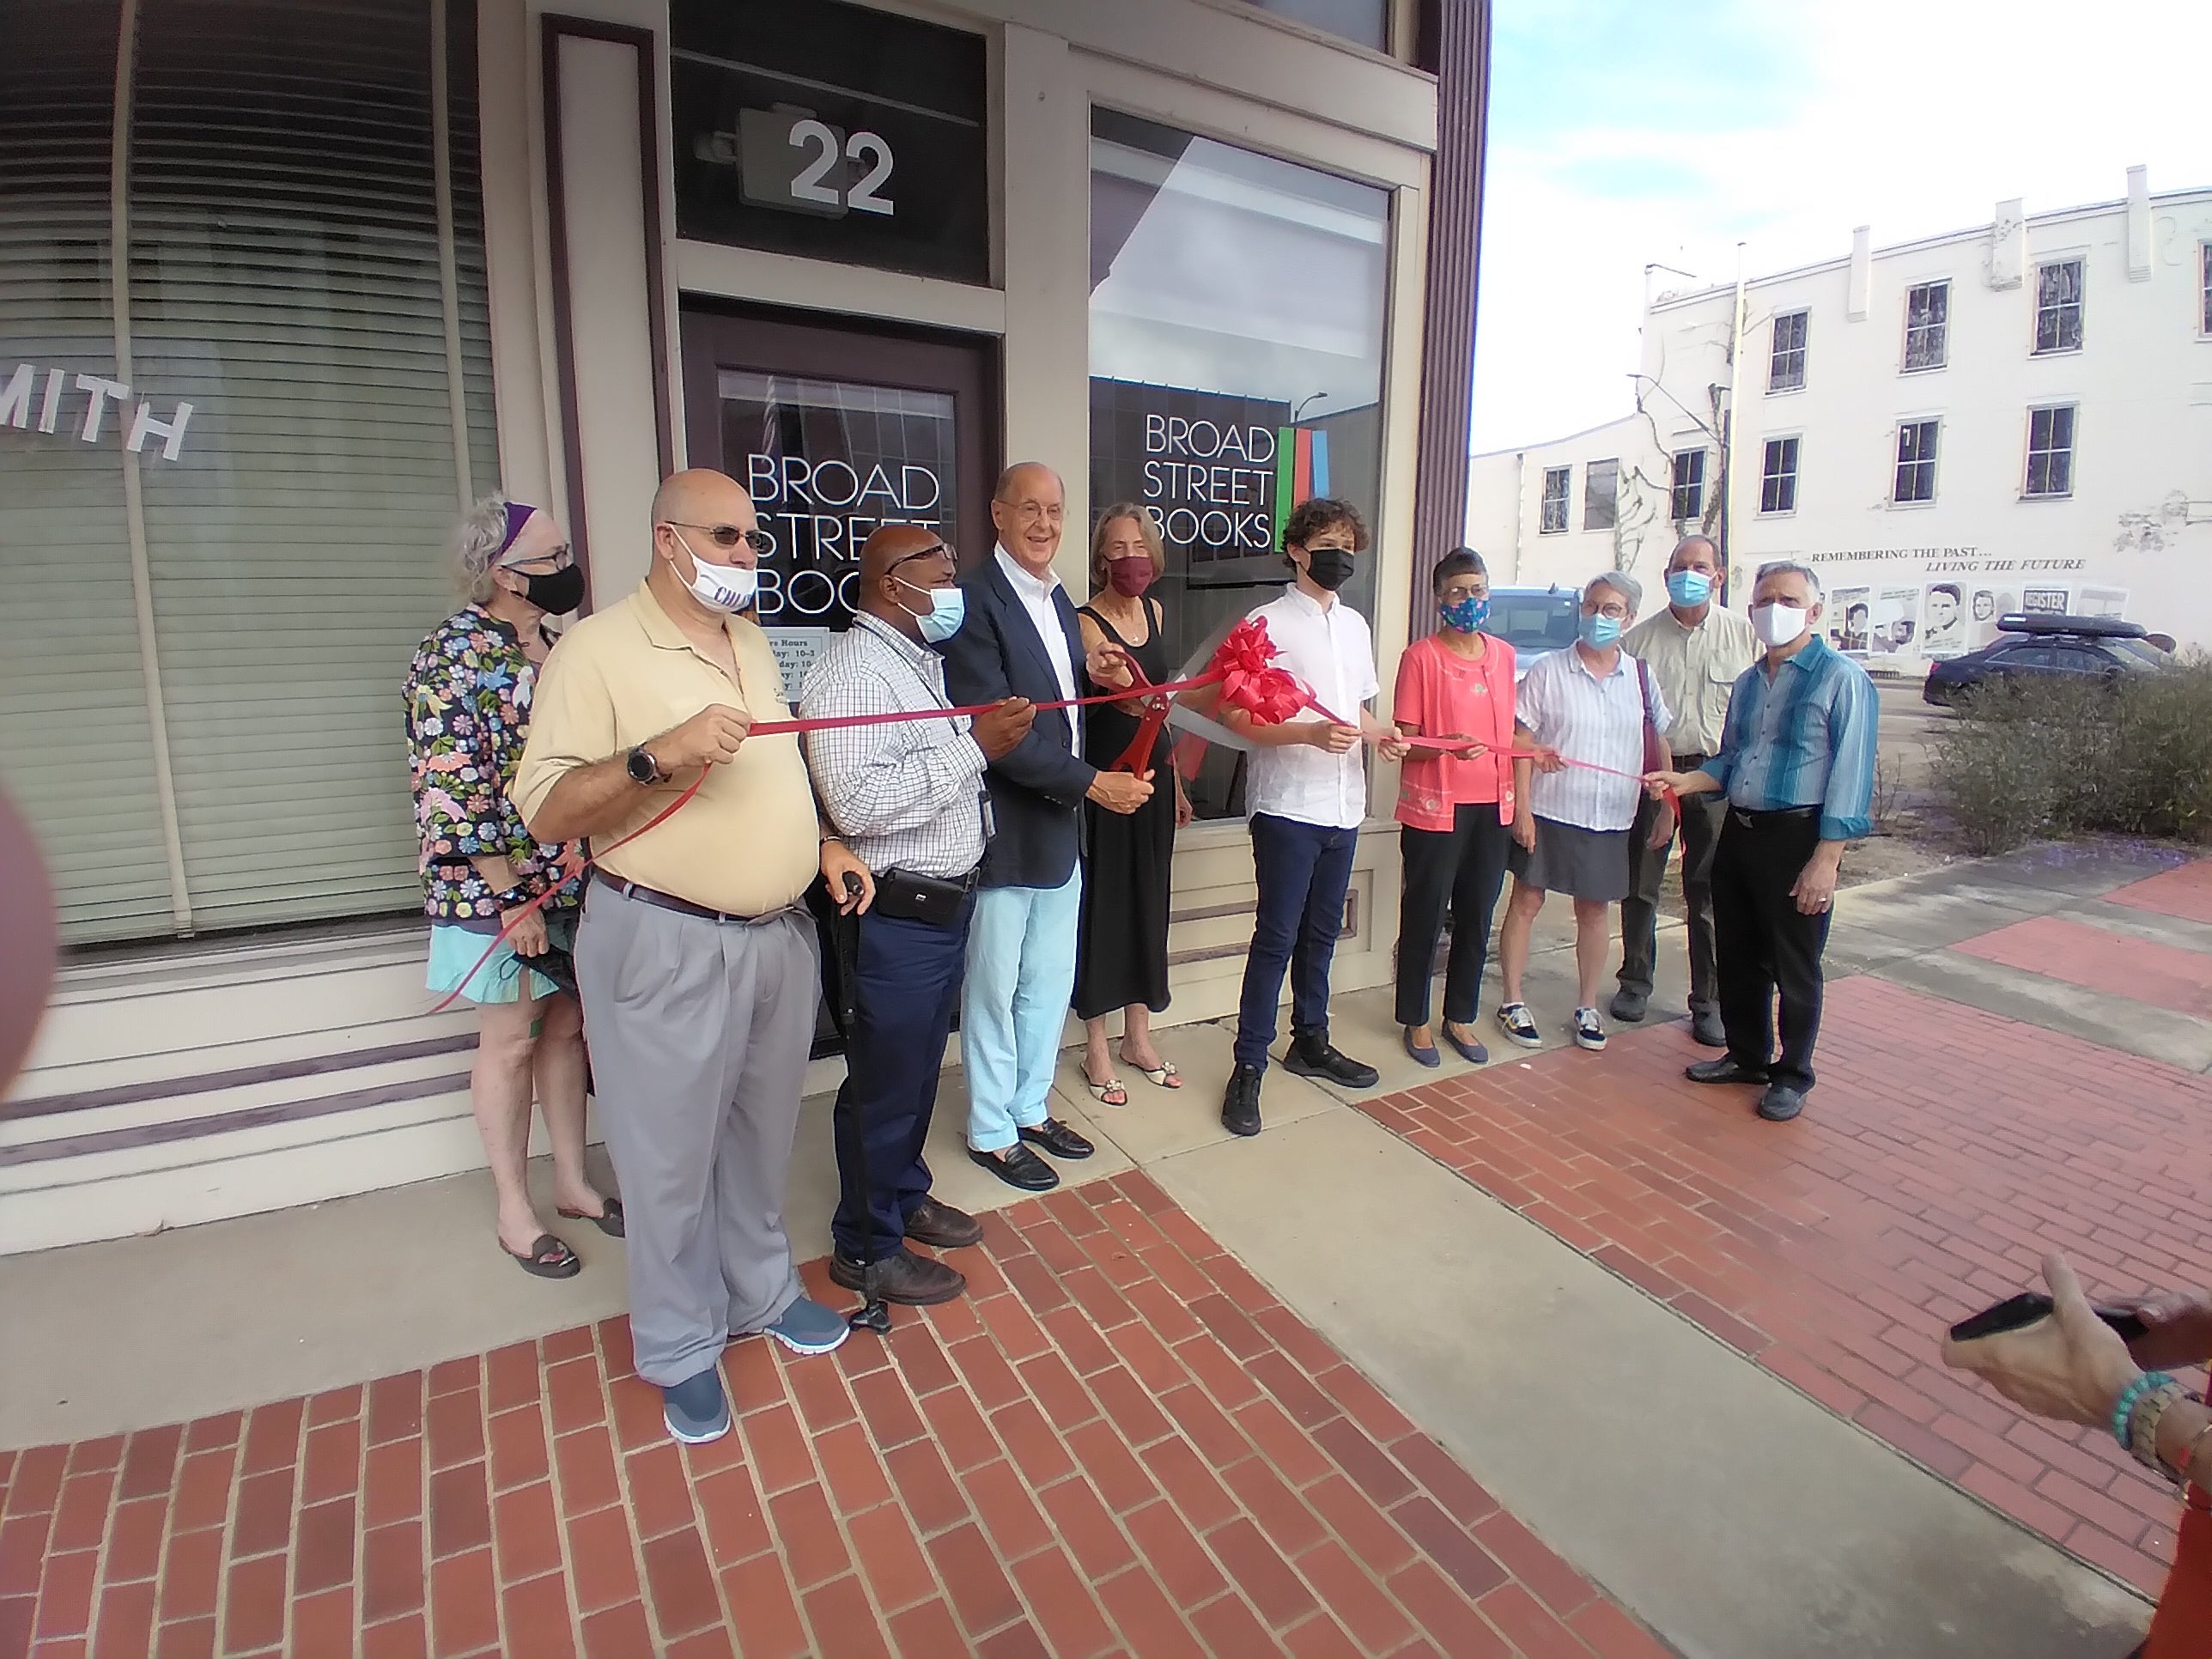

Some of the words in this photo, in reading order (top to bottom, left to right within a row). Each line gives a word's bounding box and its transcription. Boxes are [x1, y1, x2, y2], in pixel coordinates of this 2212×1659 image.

[788, 119, 895, 216] 22
[1146, 414, 1275, 463] BROAD
[748, 453, 940, 510] BROAD
[1143, 460, 1273, 506] STREET
[756, 513, 940, 561] STRE
[1146, 506, 1271, 549] BOOKS
[1812, 550, 1908, 562] REMEMBERING
[1912, 548, 1939, 558] THE
[1925, 560, 1979, 572] LIVING
[1984, 559, 2016, 571] THE
[2021, 558, 2086, 570] FUTURE
